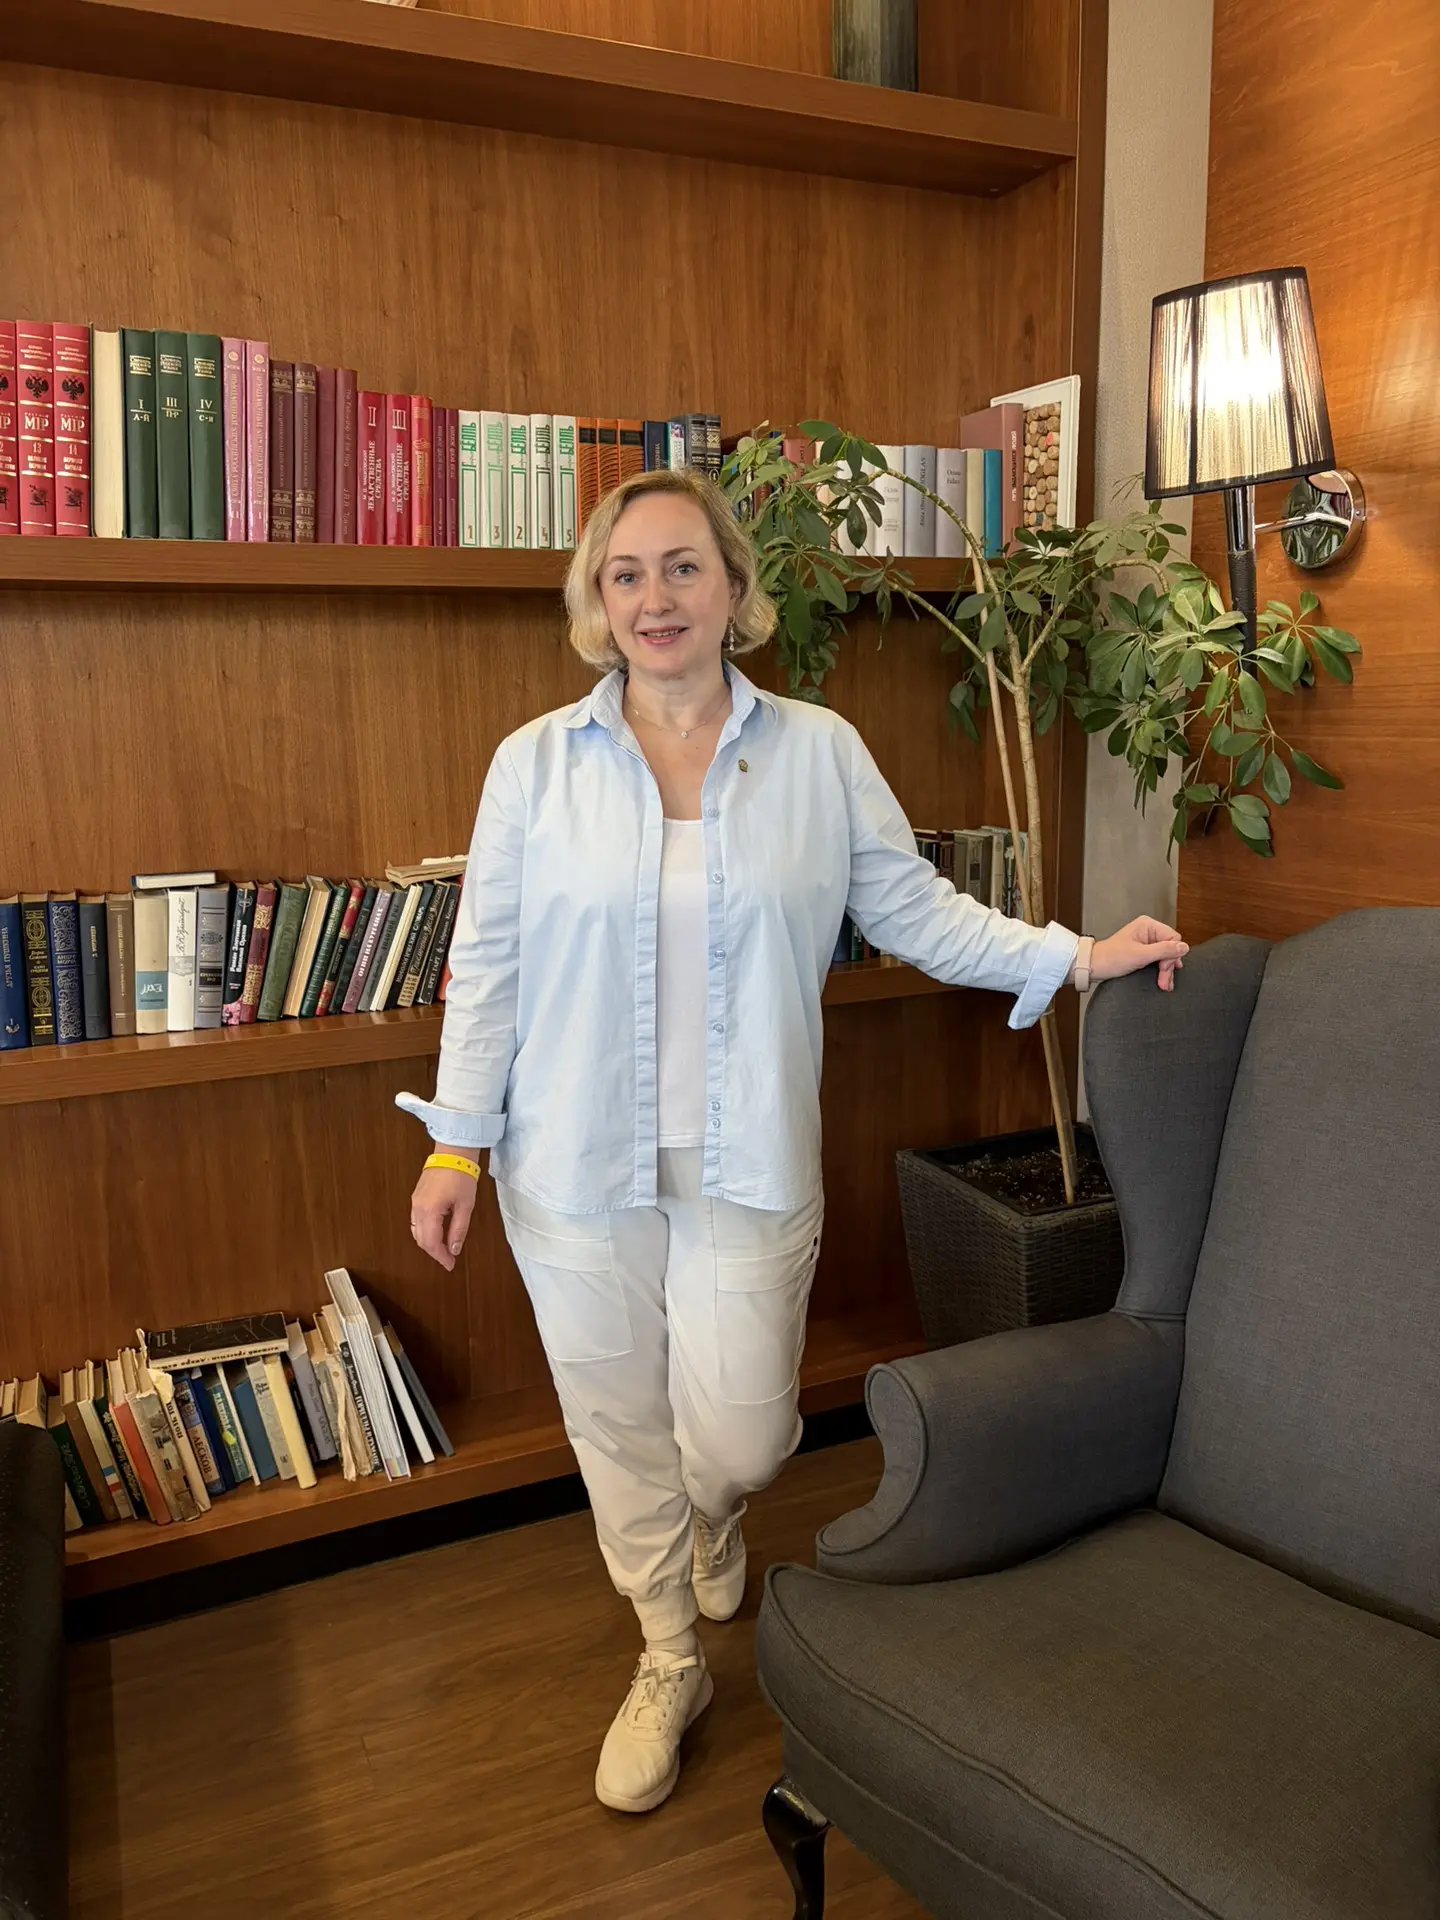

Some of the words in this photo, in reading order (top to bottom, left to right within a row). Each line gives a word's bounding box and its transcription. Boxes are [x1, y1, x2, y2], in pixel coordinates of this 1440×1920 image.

[138, 398, 144, 409] I
[166, 396, 178, 407] III
[200, 398, 212, 409] IV
[33, 442, 42, 454] 13
[343, 454, 351, 467] Ring
[368, 440, 376, 512] ЛЕКАРСТВЕННЫЕ
[396, 442, 404, 514] ЛЕКАРСТВЕННЫЕ
[468, 524, 473, 539] 1
[494, 525, 500, 540] 3
[516, 525, 523, 540] 2
[566, 528, 572, 542] 5
[232, 920, 241, 946] Злотников
[1, 926, 10, 962] ПУШКИНА
[230, 946, 238, 972] Роман
[358, 955, 370, 977] ОГНИ
[4, 964, 13, 988] ДРУЗЬЯ
[194, 1434, 213, 1474] ЛЕСКОВ
